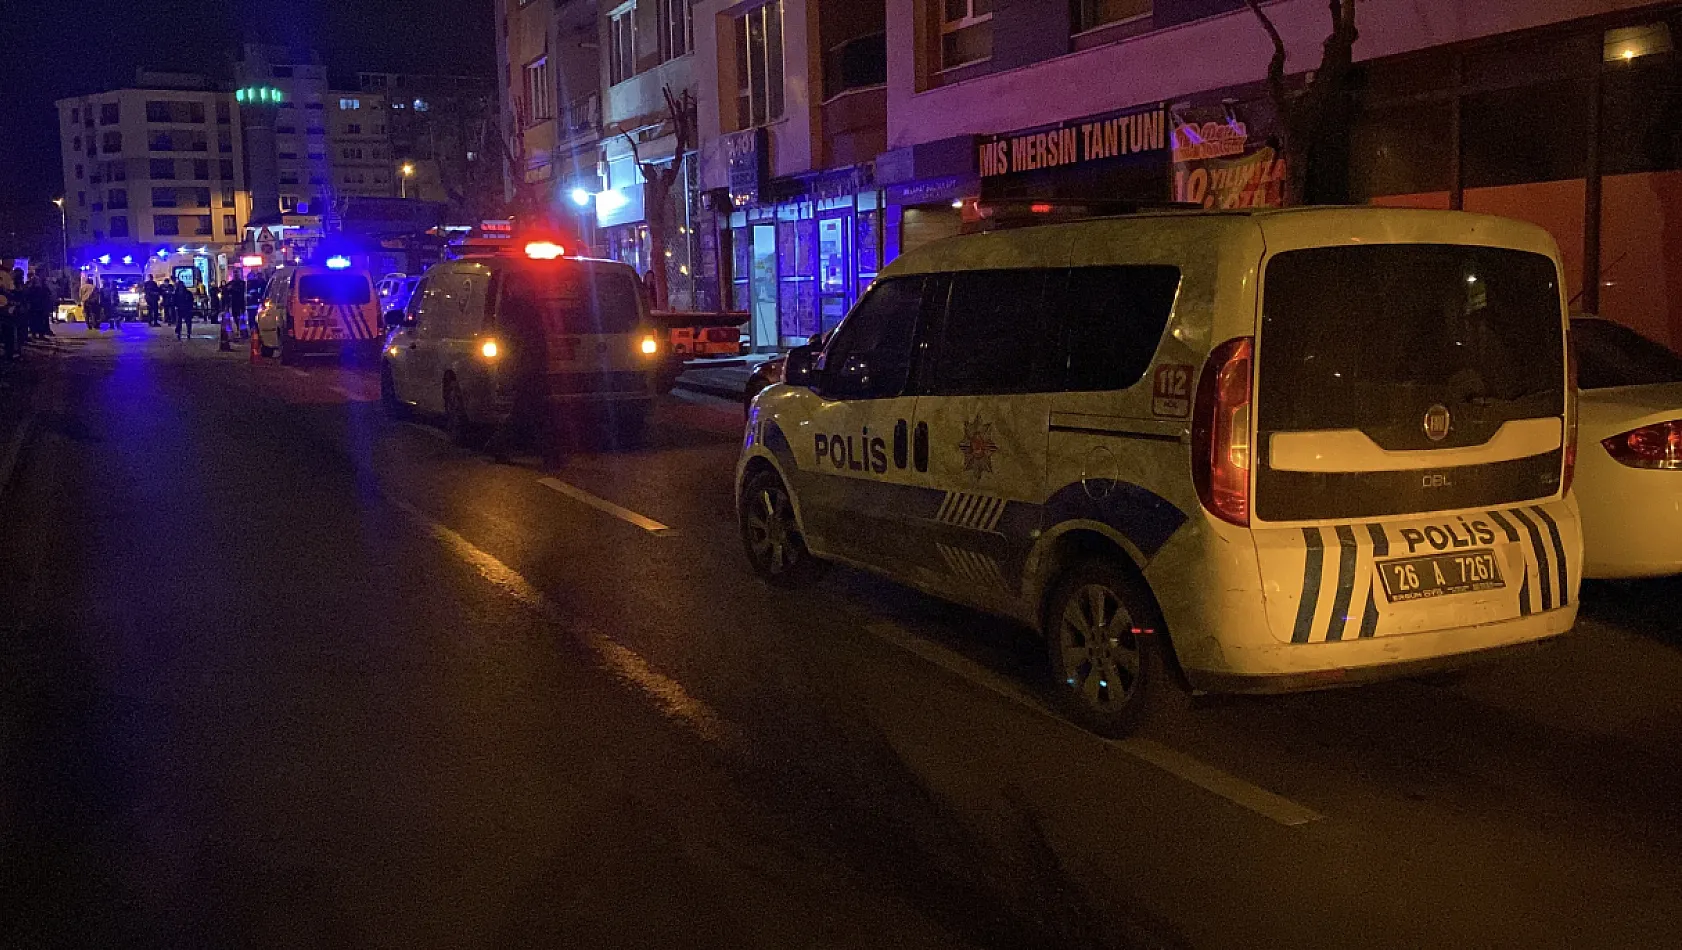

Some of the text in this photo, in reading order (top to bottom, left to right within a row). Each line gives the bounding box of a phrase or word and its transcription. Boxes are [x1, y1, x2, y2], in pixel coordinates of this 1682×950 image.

[979, 102, 1165, 177] MİS MERSİN TANTUNİ
[1160, 370, 1187, 396] 112
[815, 427, 888, 473] POLİS
[1400, 517, 1495, 553] POLİS
[1394, 554, 1495, 590] 26 A 7267
